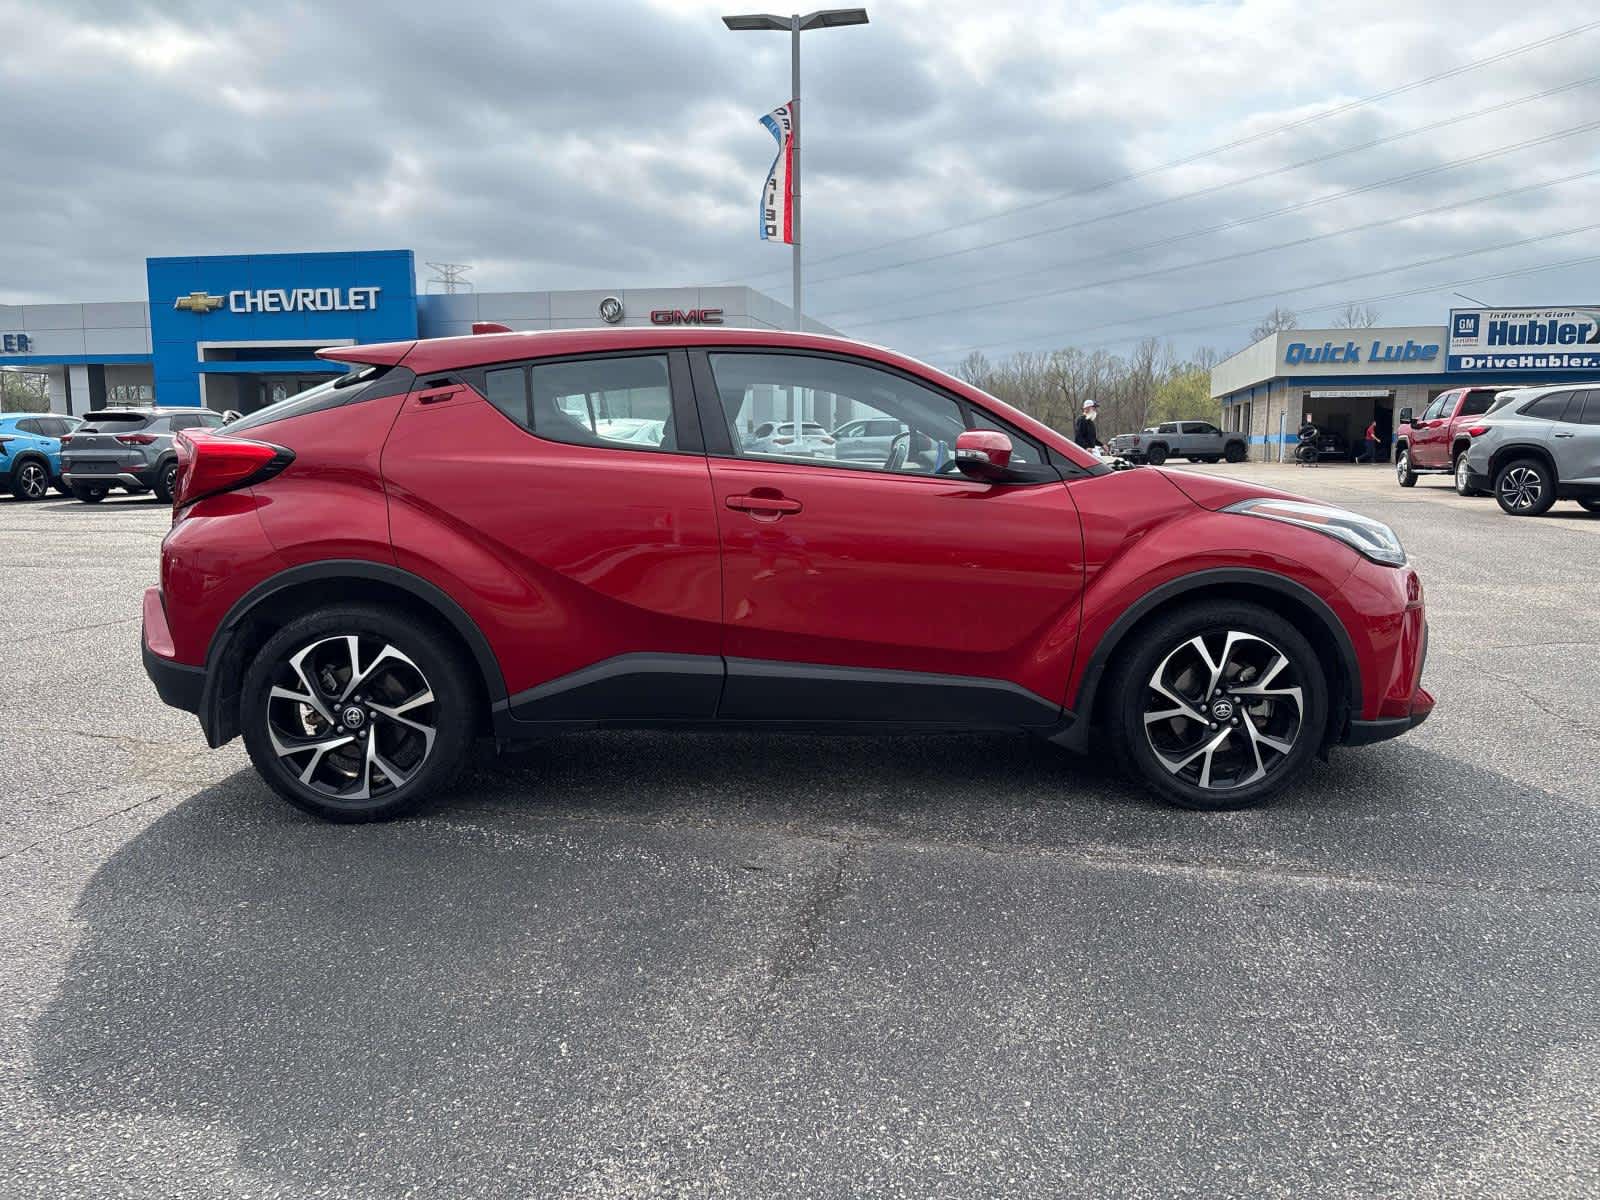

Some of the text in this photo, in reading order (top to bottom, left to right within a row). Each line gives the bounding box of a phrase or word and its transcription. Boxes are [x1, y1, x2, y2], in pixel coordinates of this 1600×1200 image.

[229, 287, 381, 313] CHEVROLET
[650, 309, 723, 325] GMC
[1459, 318, 1475, 330] GM
[1487, 319, 1592, 346] Hubler
[0, 333, 29, 352] ER
[1285, 340, 1440, 366] Quick Lube
[1461, 354, 1600, 369] DriveHubler.
